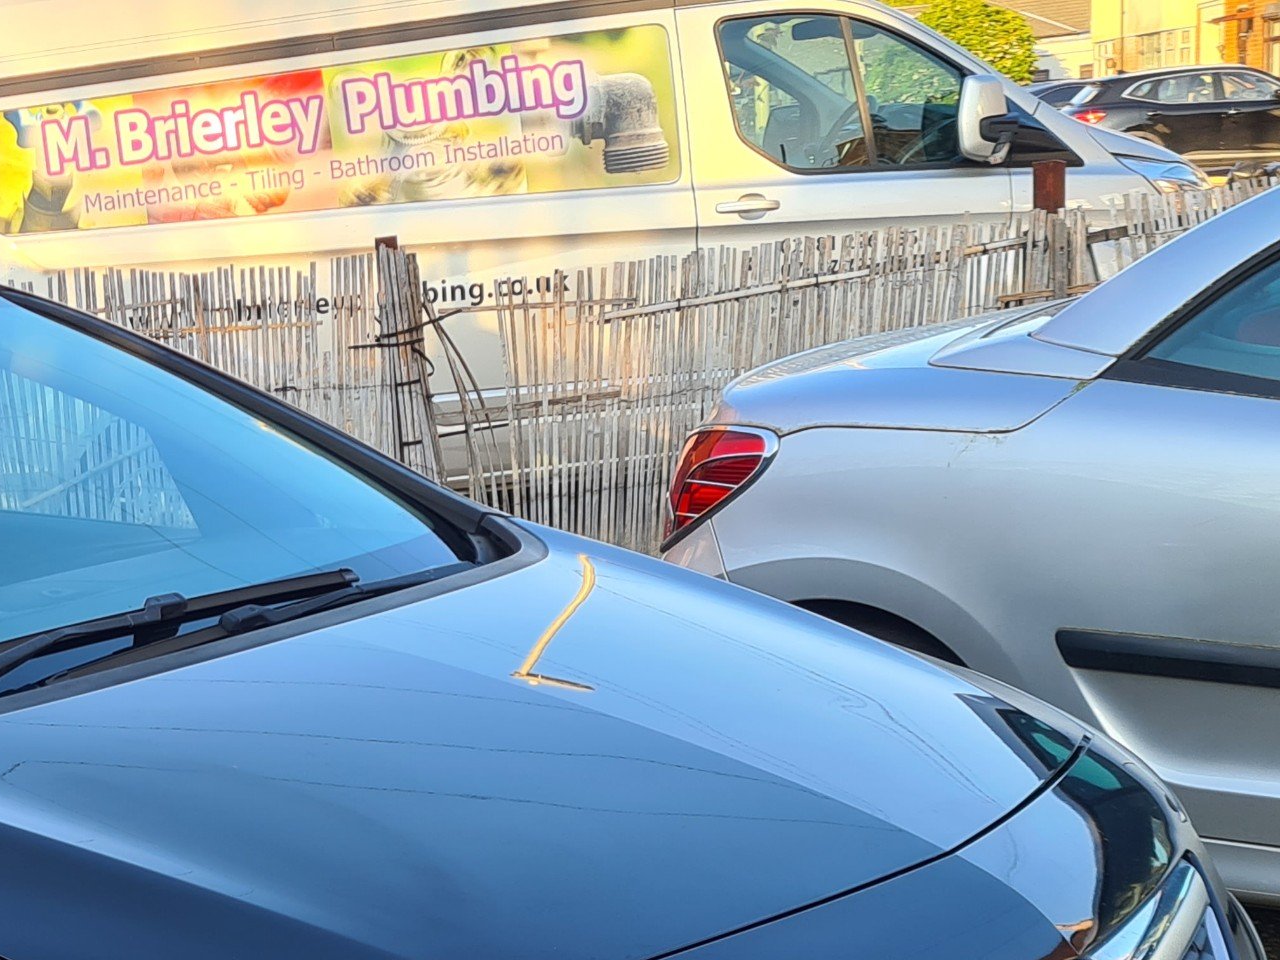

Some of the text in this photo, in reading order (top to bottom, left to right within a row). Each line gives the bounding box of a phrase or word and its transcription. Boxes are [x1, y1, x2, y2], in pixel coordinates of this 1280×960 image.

[41, 54, 588, 176] M. Brierley Plumbing
[84, 180, 222, 214] Maintenance
[246, 168, 304, 191] Tiling
[330, 150, 435, 180] Bathroom
[444, 133, 564, 164] Installation
